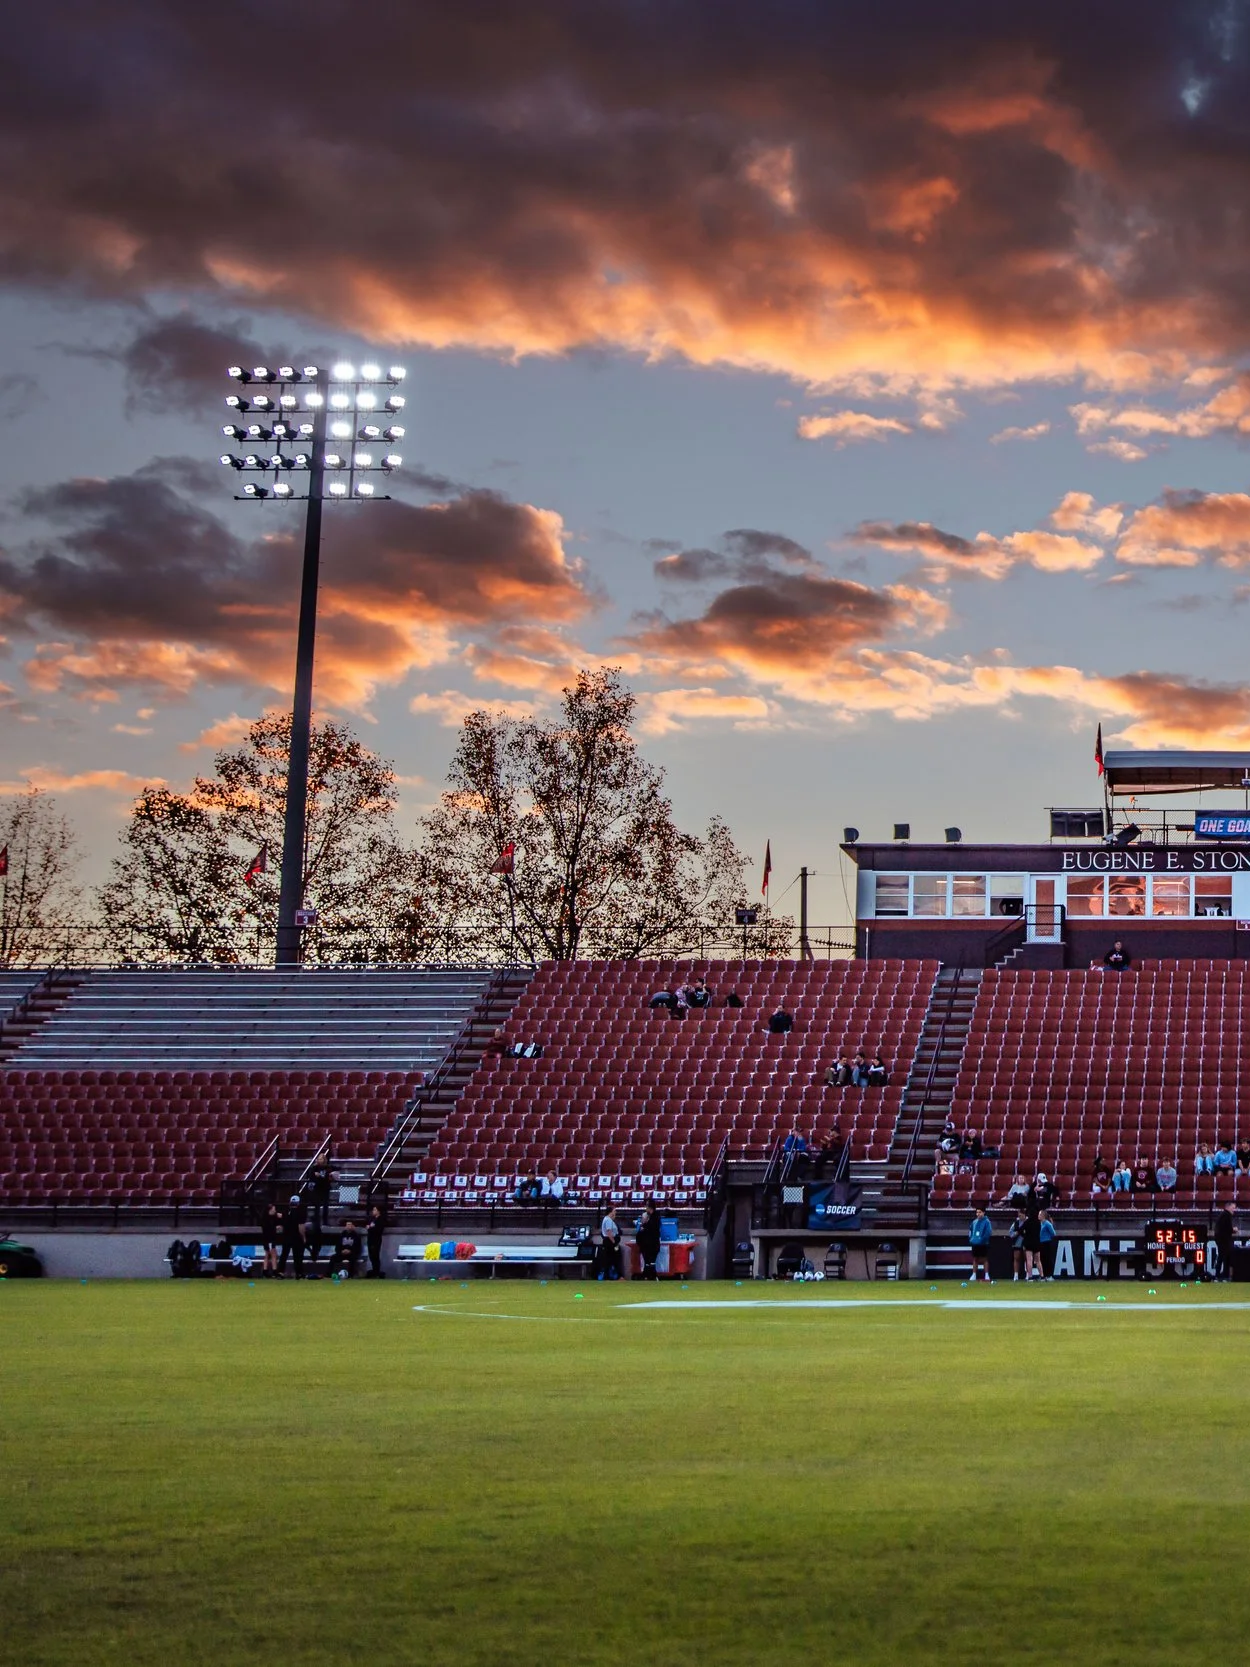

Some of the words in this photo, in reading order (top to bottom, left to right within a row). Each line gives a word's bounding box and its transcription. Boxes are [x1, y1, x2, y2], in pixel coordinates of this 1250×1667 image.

[1199, 819, 1225, 832] ONE
[1061, 851, 1155, 870] EUGENE
[1166, 851, 1184, 870] E.
[303, 916, 308, 924] 3
[826, 1205, 857, 1215] SOCCER
[1156, 1230, 1195, 1243] 52:15
[1147, 1242, 1166, 1250] HOME
[1184, 1242, 1204, 1250] GUEST
[1157, 1250, 1164, 1263] 0
[1196, 1250, 1203, 1263] 0
